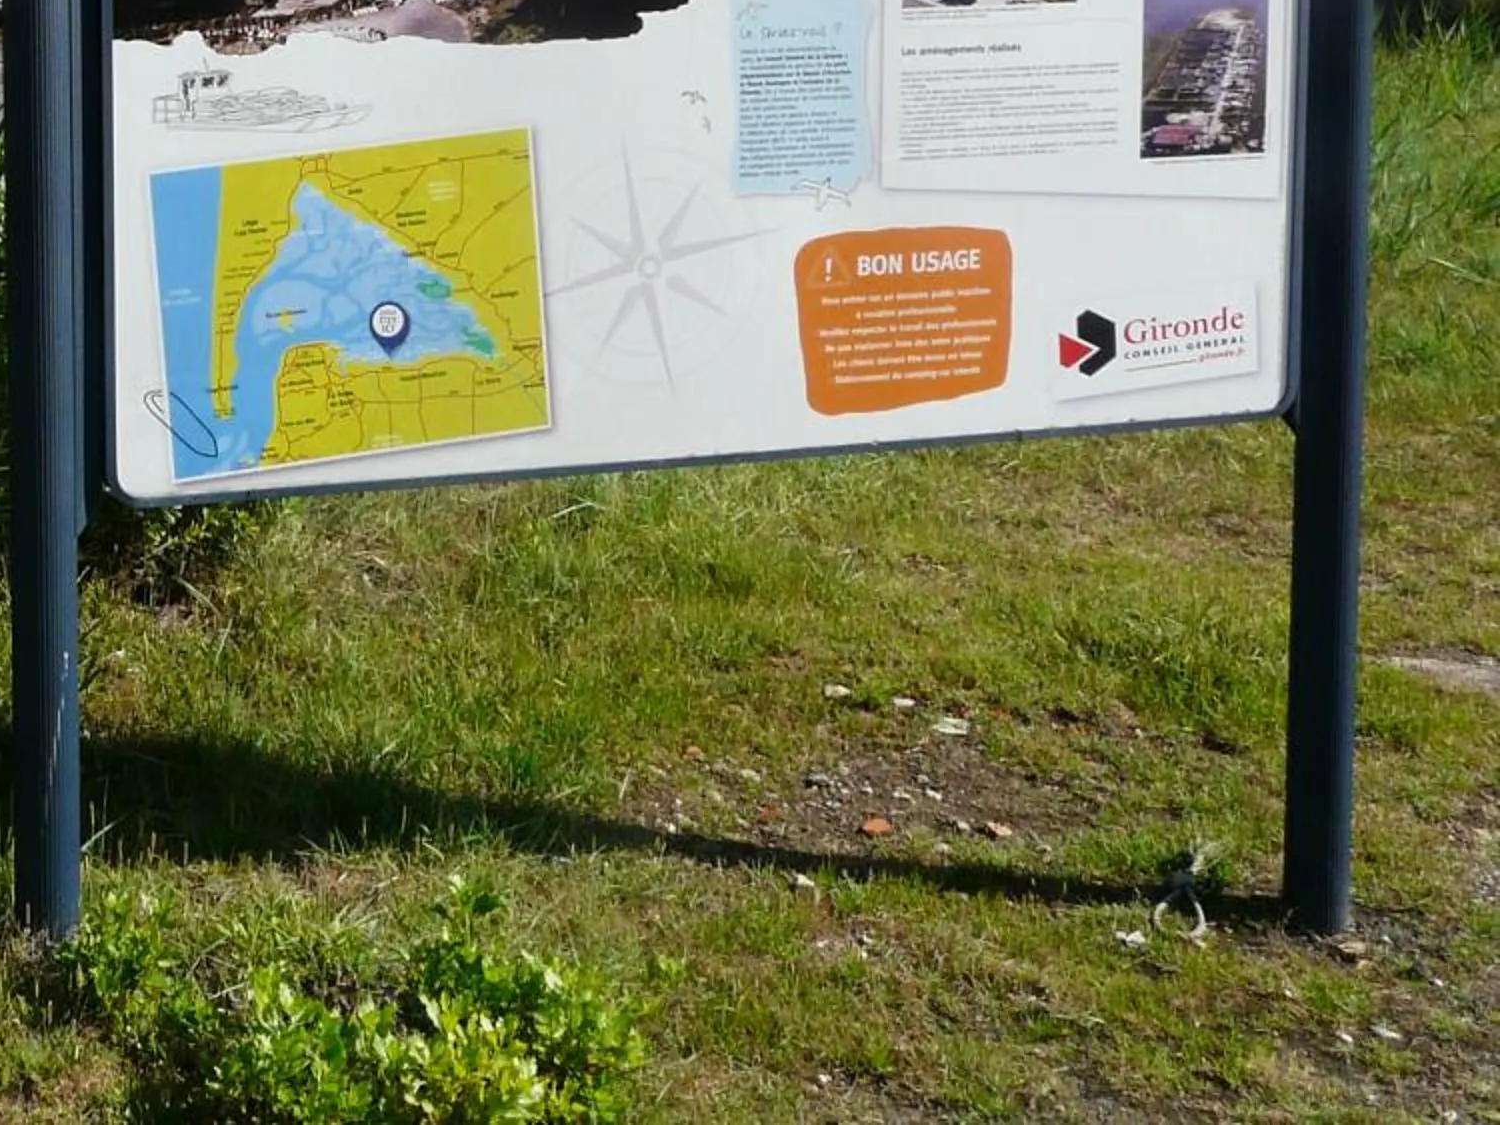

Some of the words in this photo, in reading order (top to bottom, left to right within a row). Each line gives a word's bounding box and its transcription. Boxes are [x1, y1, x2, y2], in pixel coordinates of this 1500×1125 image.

[856, 253, 903, 277] BON
[911, 248, 982, 273] USAGE
[1123, 306, 1245, 345] Gironde
[1123, 346, 1179, 361] CONSEIL
